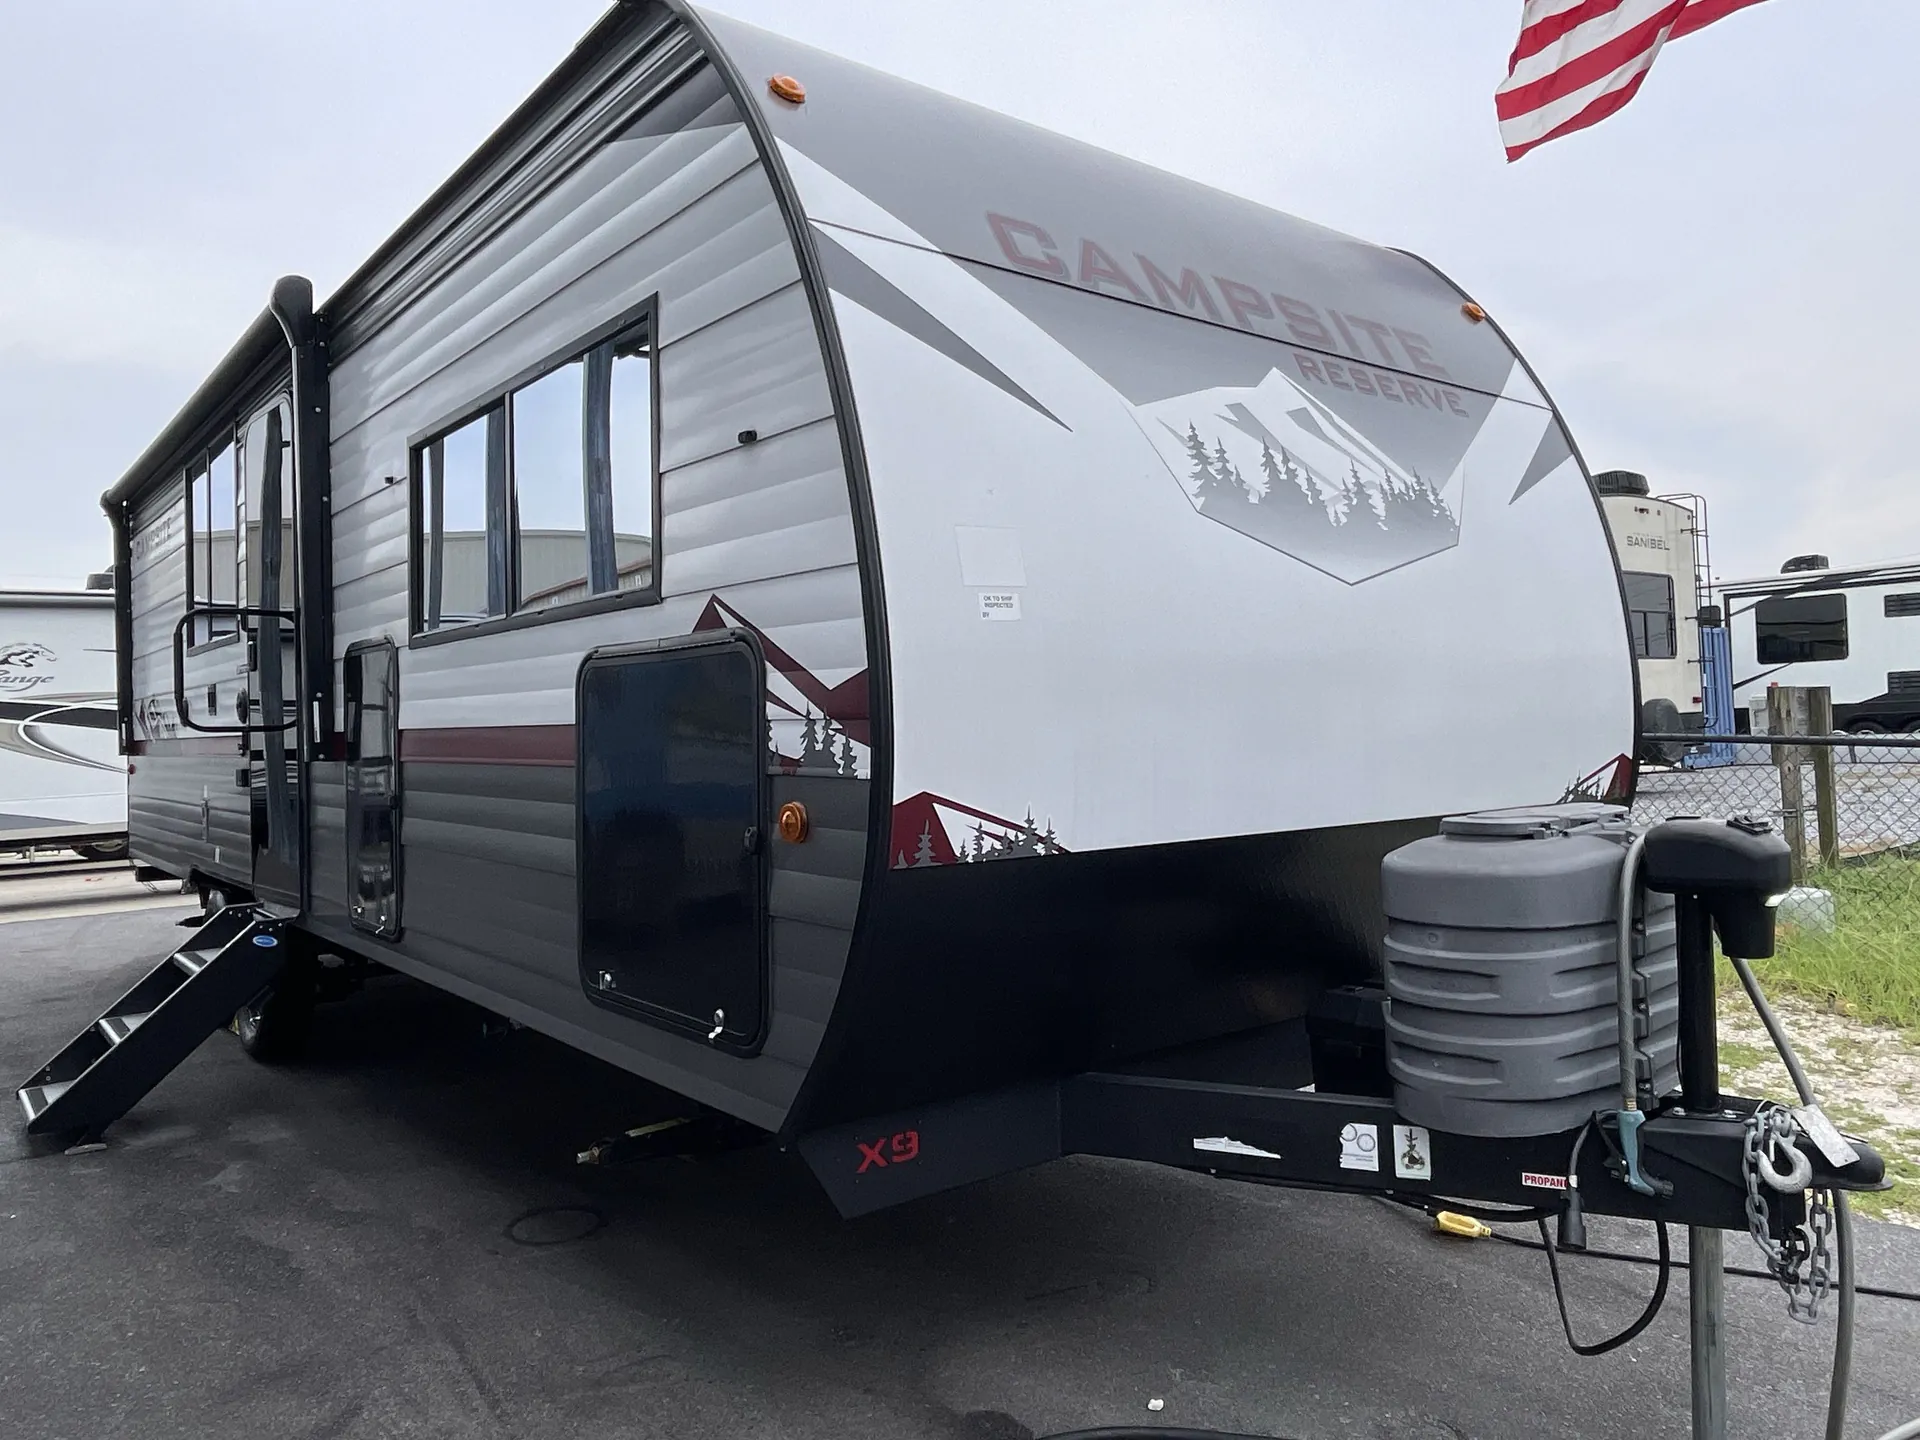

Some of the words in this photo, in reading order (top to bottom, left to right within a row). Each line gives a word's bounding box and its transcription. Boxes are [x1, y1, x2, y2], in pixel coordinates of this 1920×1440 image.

[985, 210, 1452, 380] CAMPSITE
[1292, 352, 1470, 418] RESERVE
[1626, 535, 1670, 551] SANIBEL
[856, 1131, 919, 1174] X9
